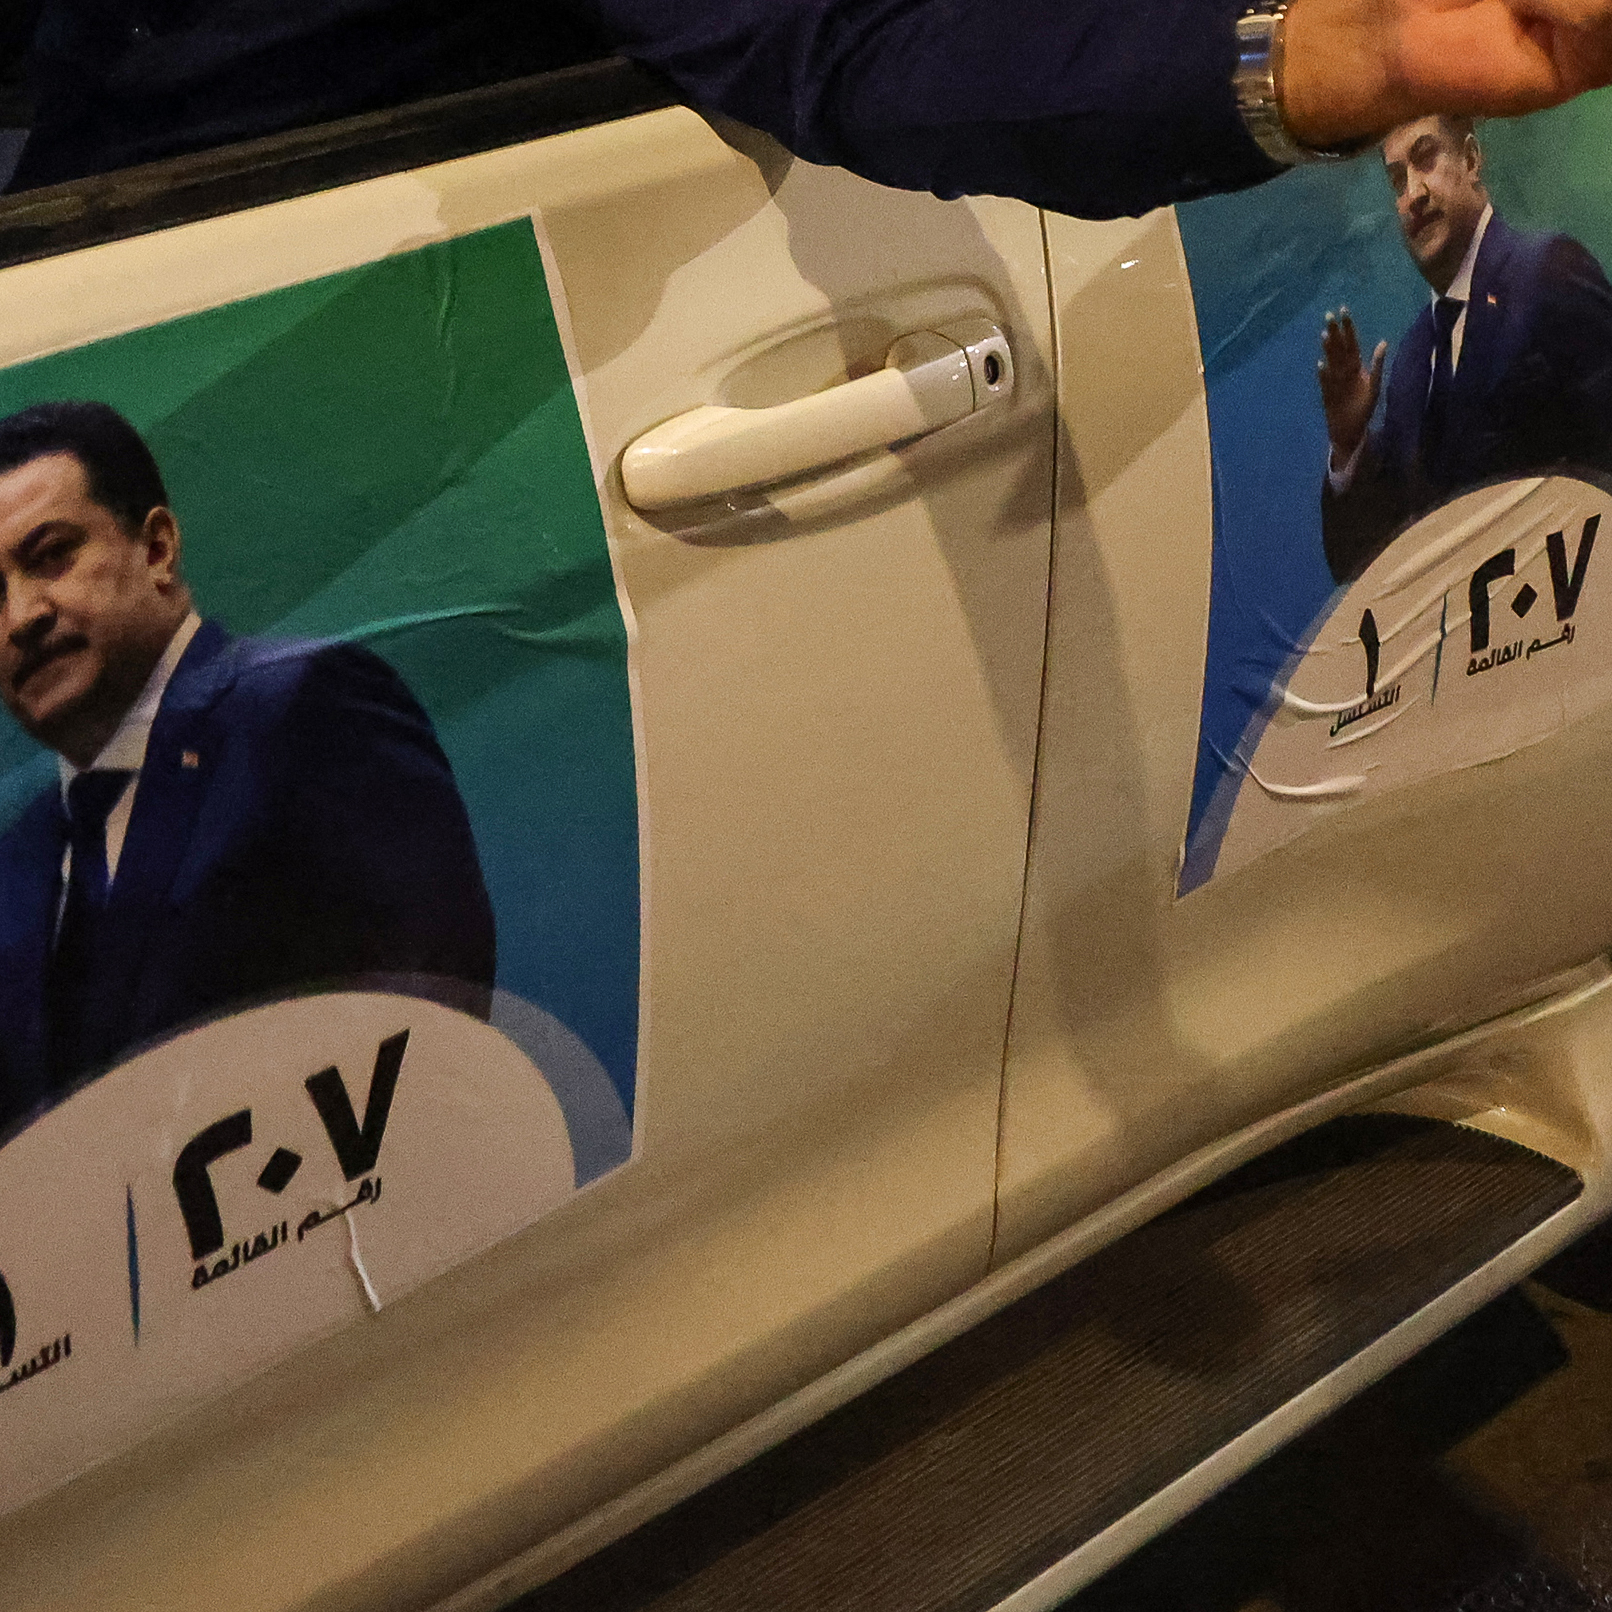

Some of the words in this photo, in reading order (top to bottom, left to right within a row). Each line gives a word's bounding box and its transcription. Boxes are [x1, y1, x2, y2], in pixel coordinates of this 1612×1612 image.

[1358, 608, 1380, 699] ١
[1469, 513, 1602, 654] ٢٠٧
[172, 1026, 411, 1262] ٢٠٧
